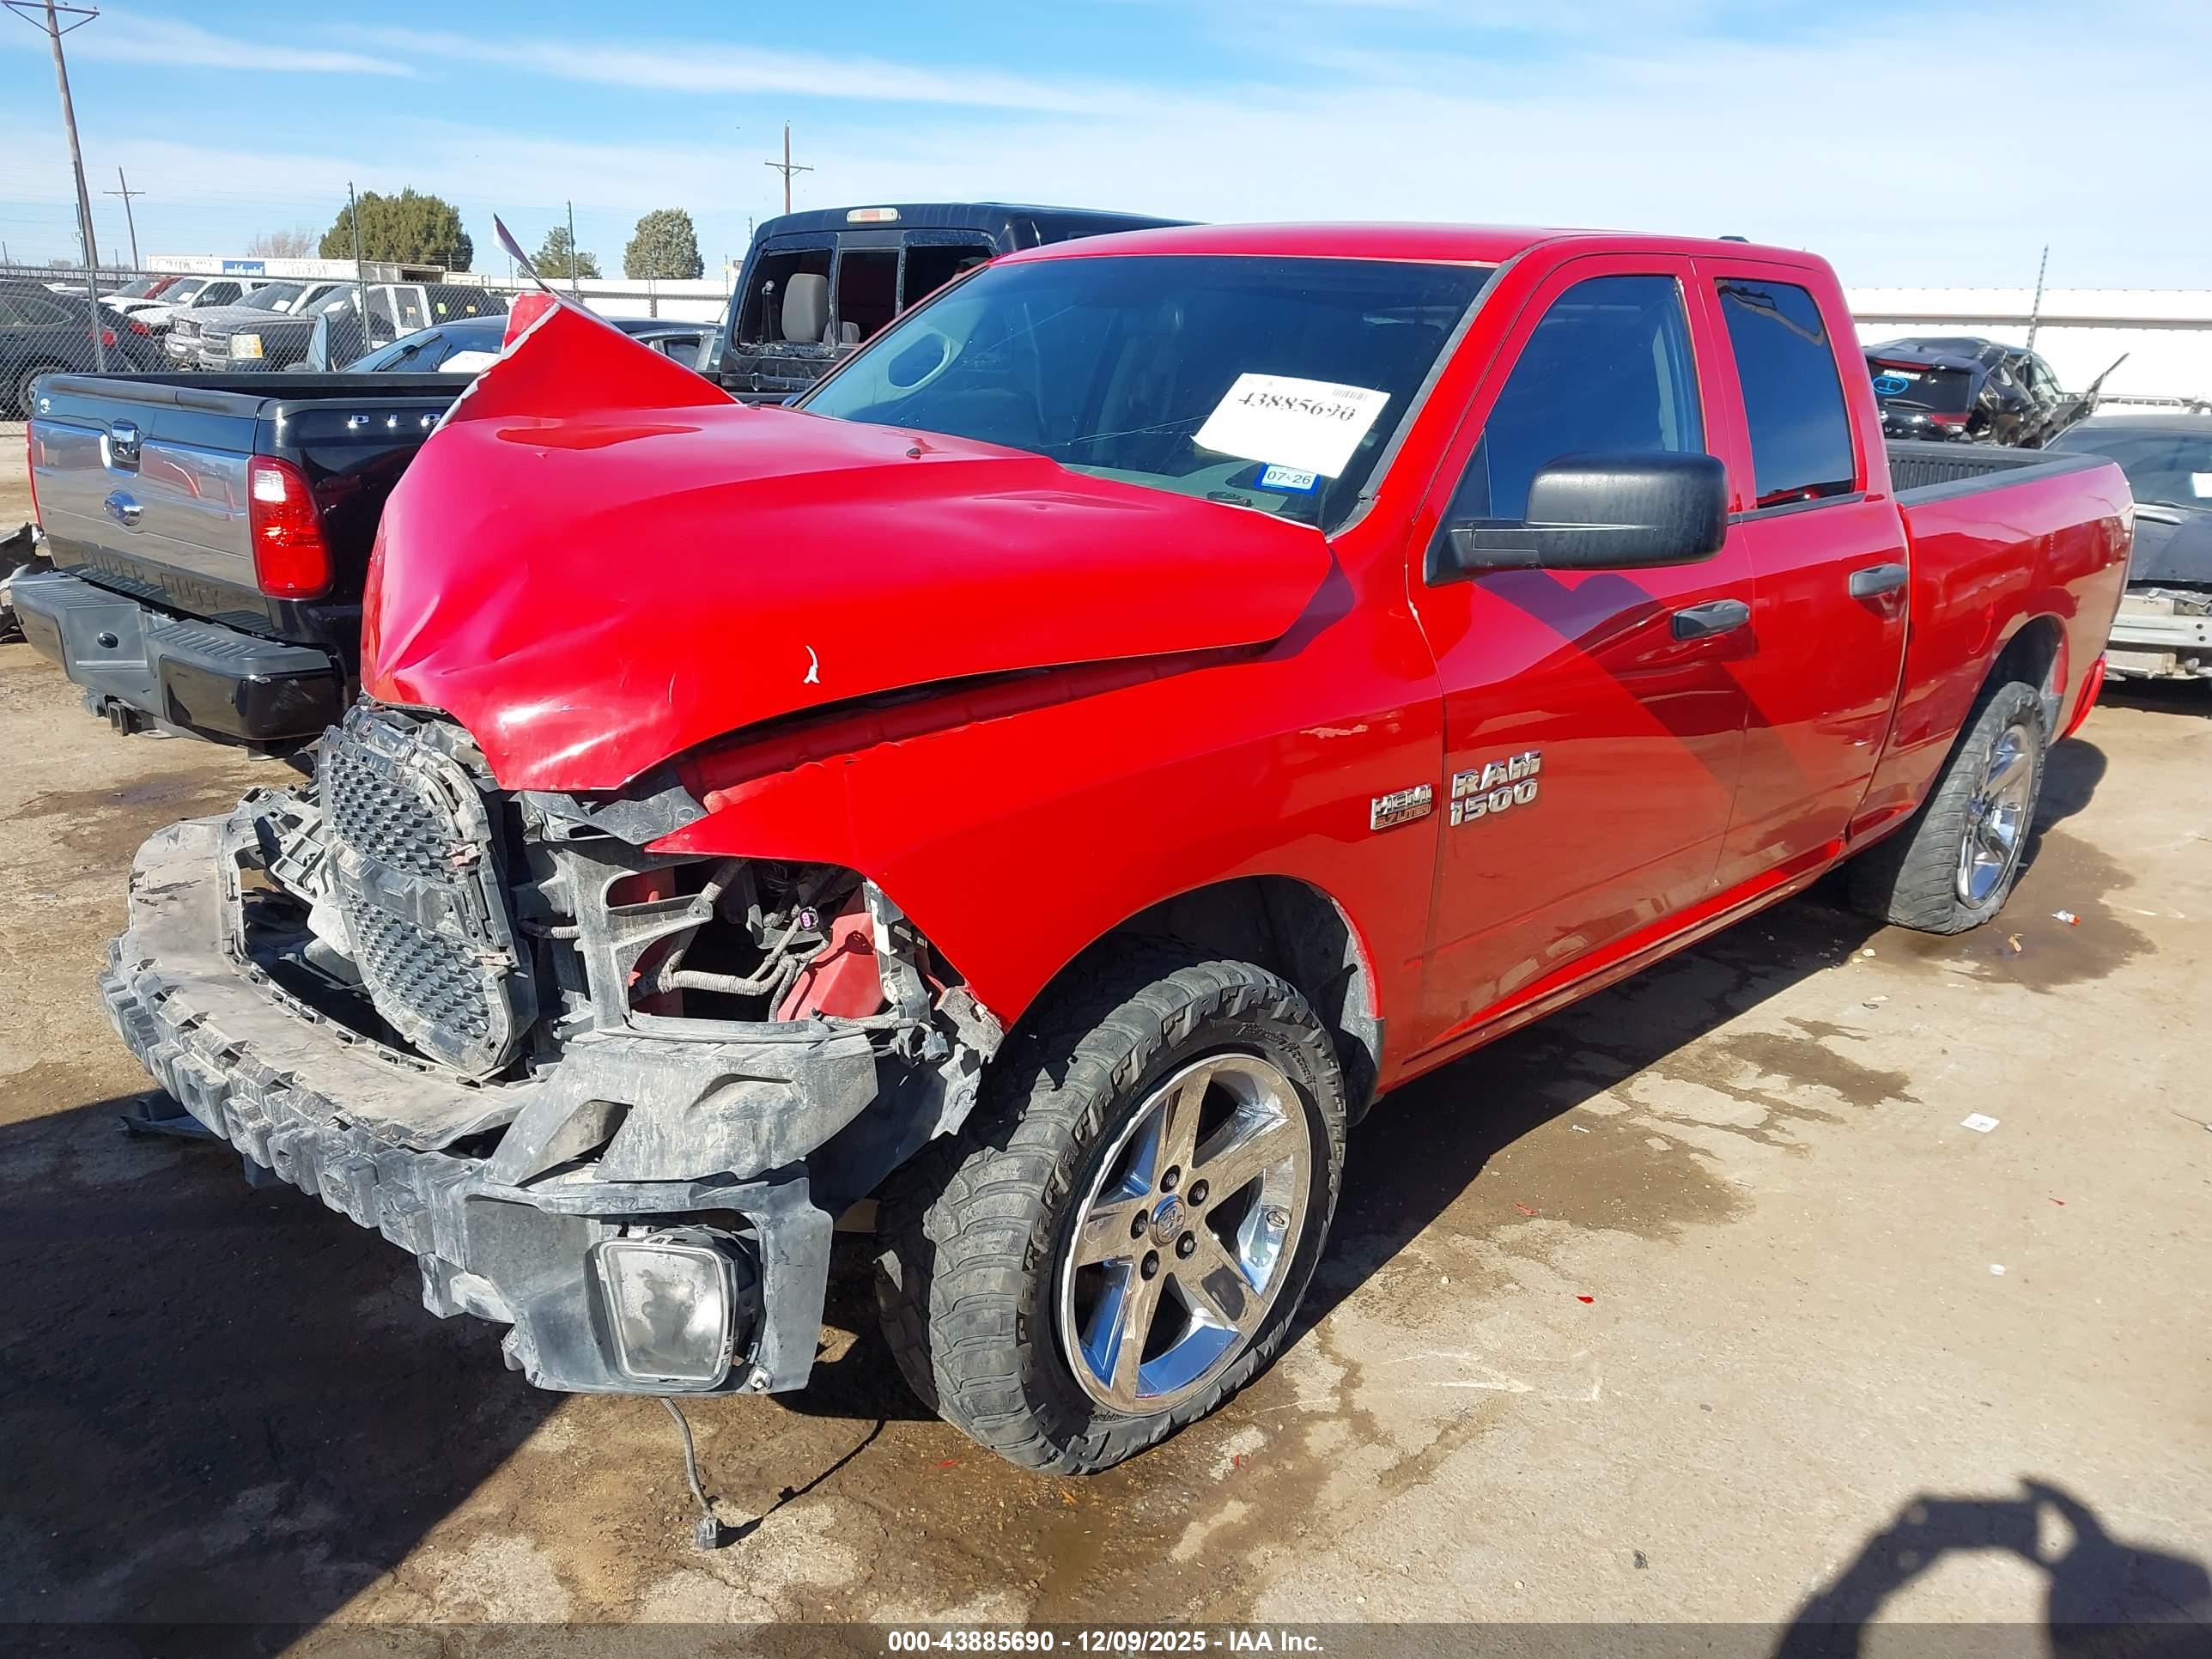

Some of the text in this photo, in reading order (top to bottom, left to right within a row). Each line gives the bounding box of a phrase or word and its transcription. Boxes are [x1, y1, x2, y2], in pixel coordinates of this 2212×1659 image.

[1238, 392, 1356, 421] 43885690
[1451, 750, 1541, 799] RAM
[1374, 783, 1432, 817] HEMI
[1376, 803, 1431, 827] 5.7 LITER
[1450, 778, 1540, 827] 1500
